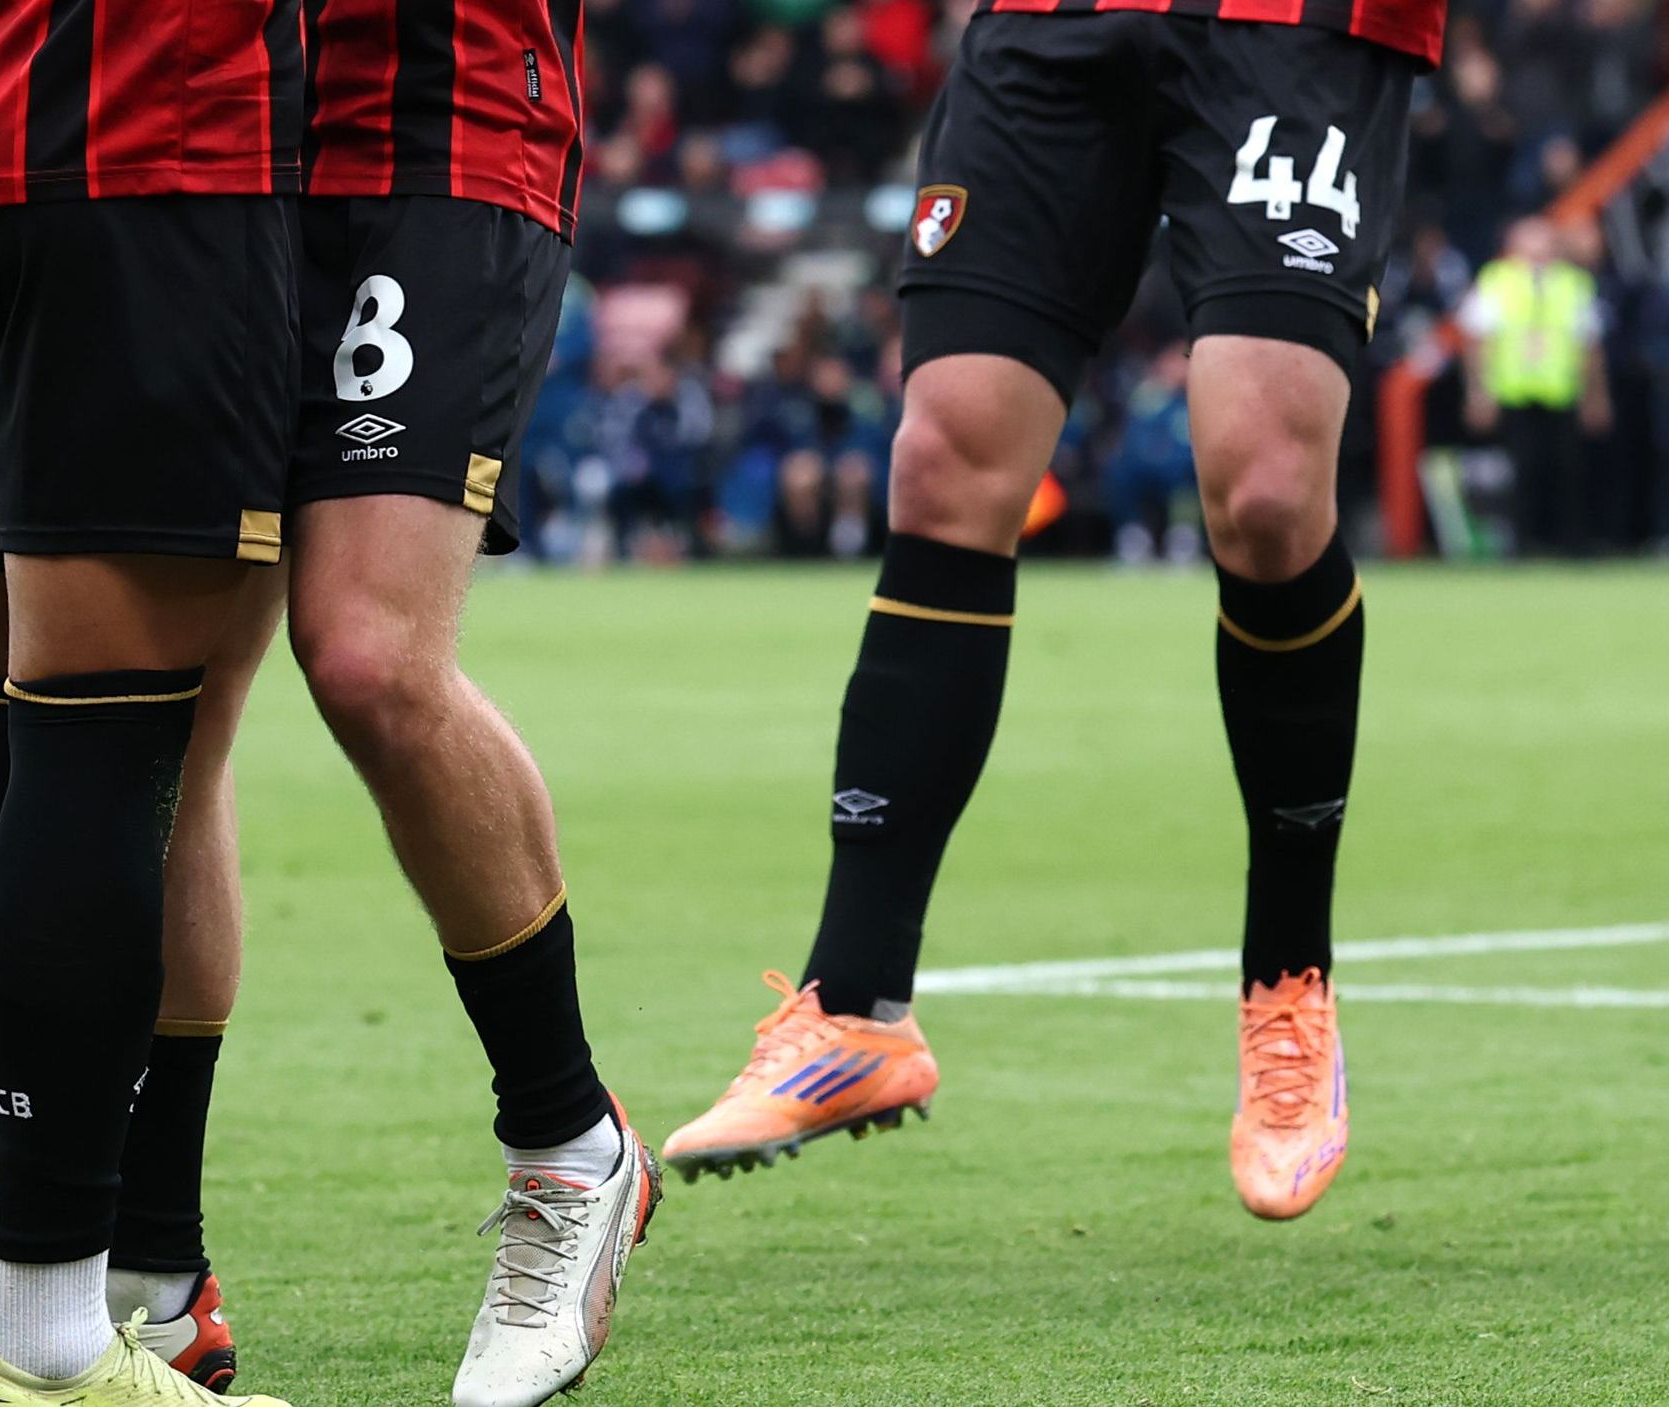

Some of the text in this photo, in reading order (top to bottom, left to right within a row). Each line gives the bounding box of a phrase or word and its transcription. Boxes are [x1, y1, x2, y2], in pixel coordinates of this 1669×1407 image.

[1226, 114, 1361, 240] 44
[333, 274, 415, 402] 8
[341, 444, 399, 463] umbro
